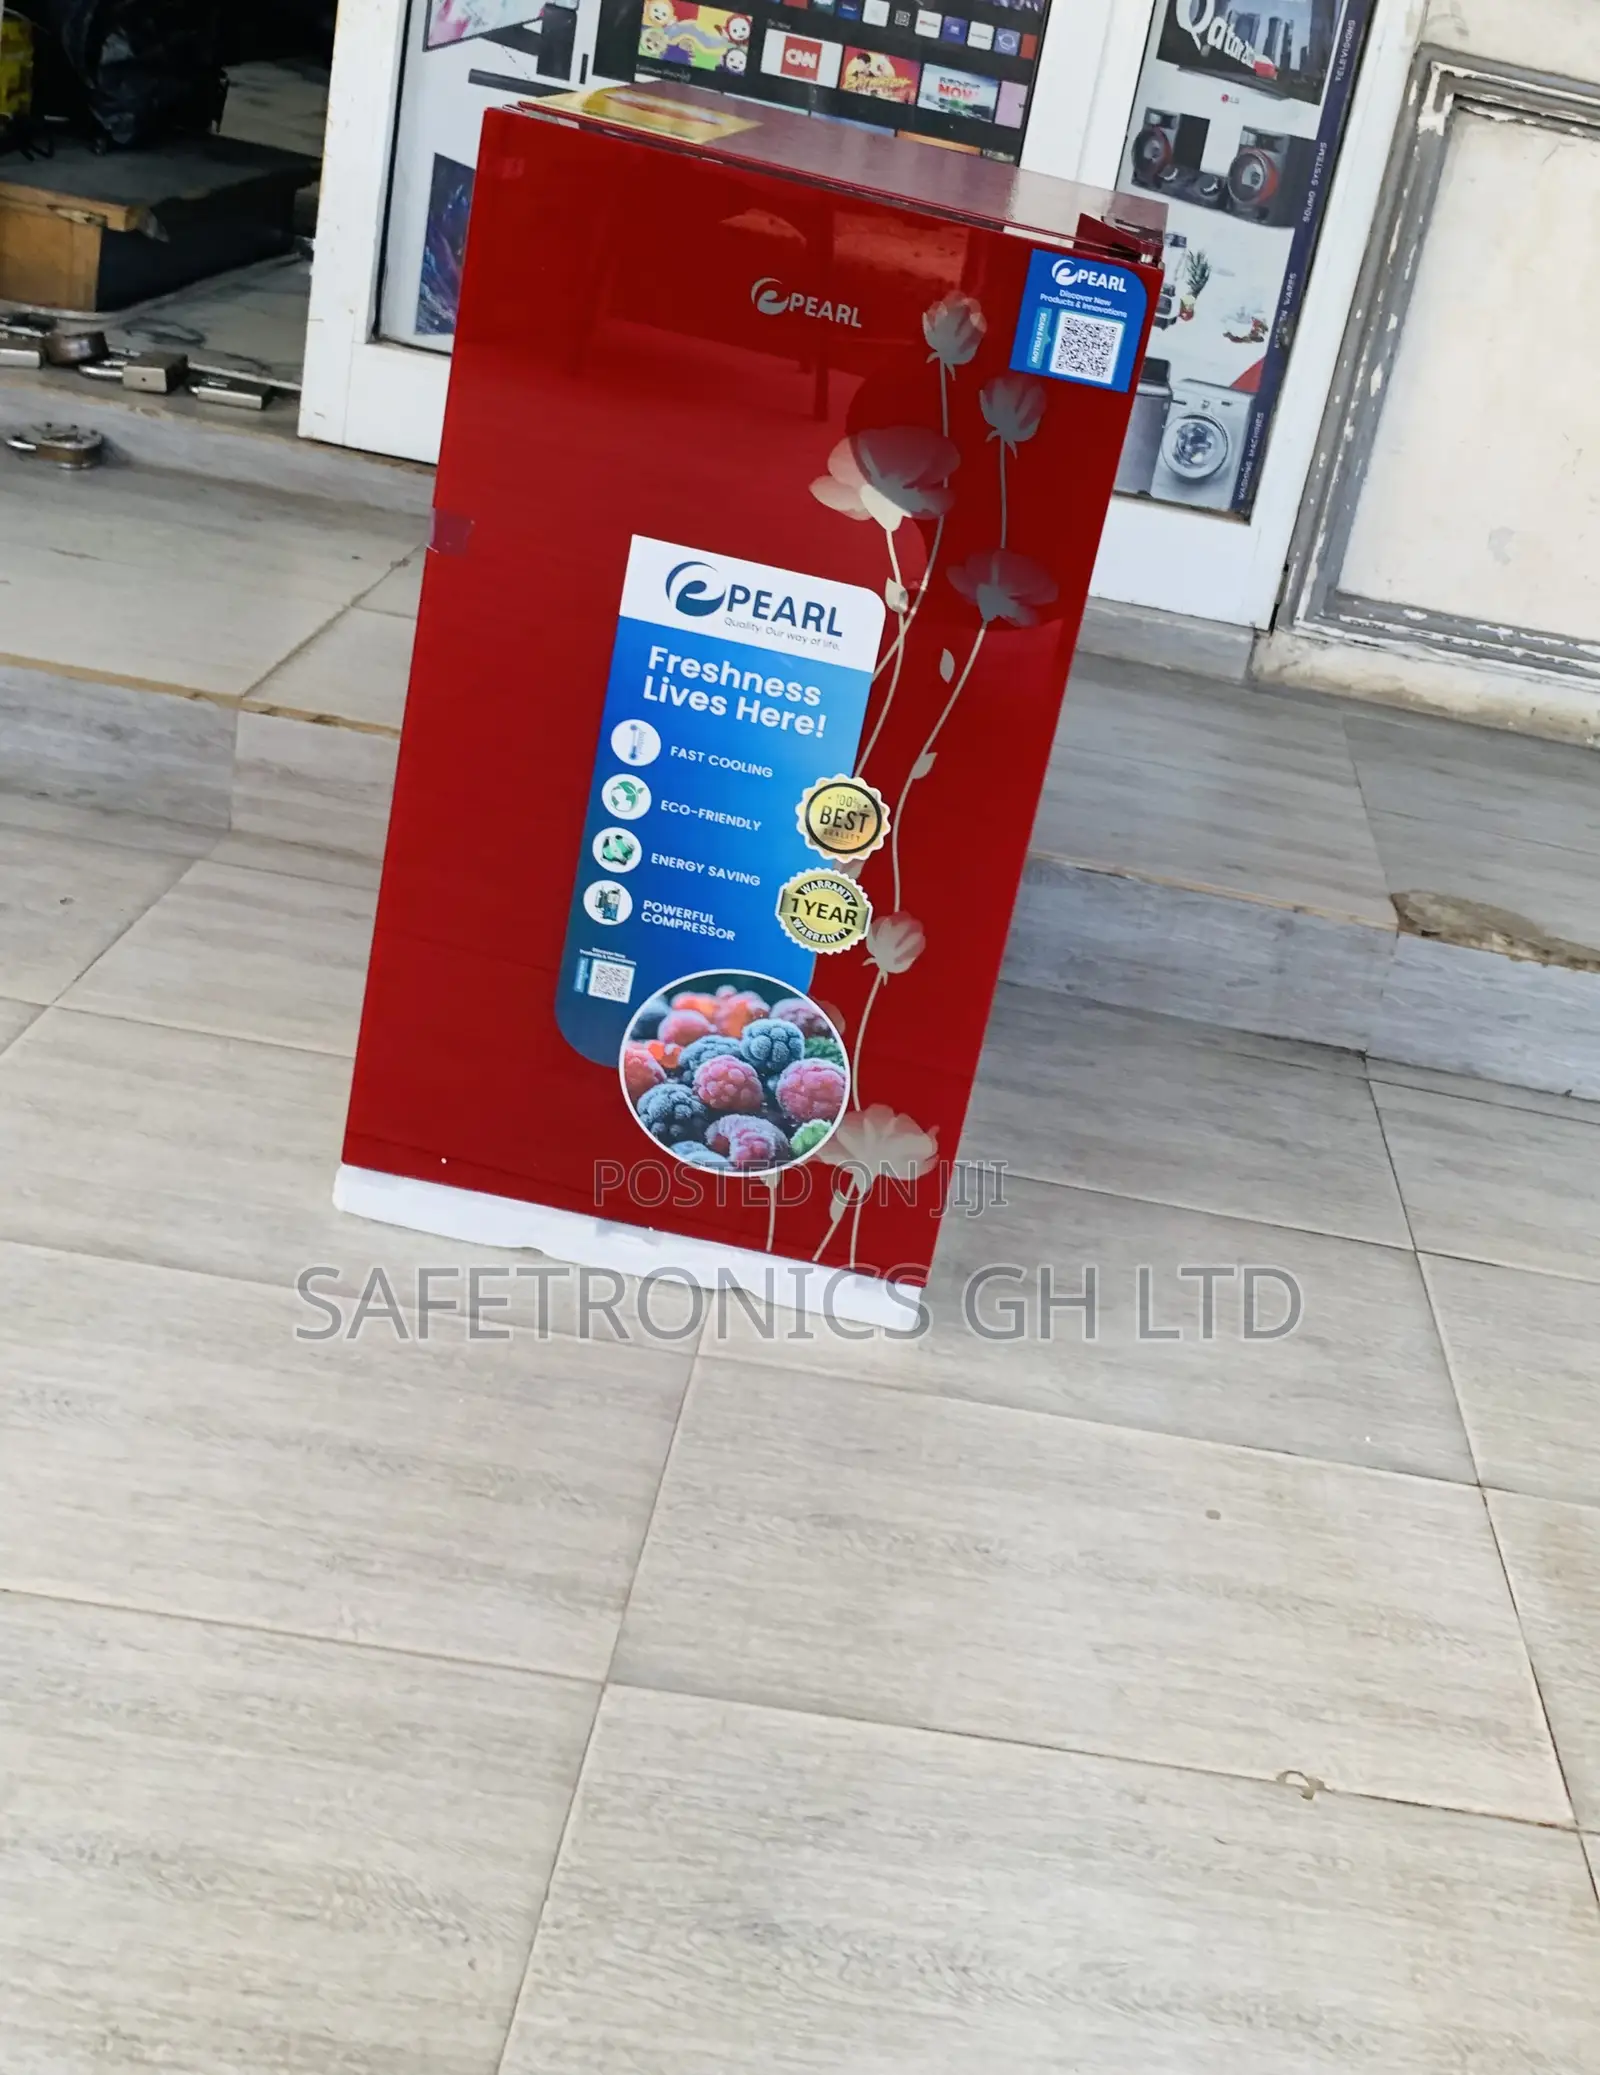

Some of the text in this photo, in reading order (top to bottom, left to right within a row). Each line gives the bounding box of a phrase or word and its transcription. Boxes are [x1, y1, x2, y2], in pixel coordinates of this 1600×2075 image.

[785, 48, 818, 69] CNN
[1335, 19, 1357, 82] TELEVISIONS
[1303, 142, 1328, 223] SOUND SYSTEMS
[1040, 293, 1075, 308] Products
[1082, 302, 1128, 319] Innovations
[1059, 289, 1112, 307] Discover New
[765, 626, 784, 638] Our
[786, 633, 808, 645] way
[810, 637, 821, 646] of
[648, 645, 822, 707] Freshness
[643, 675, 828, 738] Lives Here!
[670, 745, 774, 778] FAST COOLING
[660, 799, 762, 832] ECO-FRIENDLY
[819, 805, 870, 835] BEST
[651, 852, 761, 887] ENERGY SAVING
[800, 880, 856, 904] WARRANTY
[640, 911, 736, 942] COMPRESSOR
[642, 900, 716, 926] POWERFUL
[790, 897, 859, 926] 1 YEAR
[792, 917, 848, 944] WARRANTY
